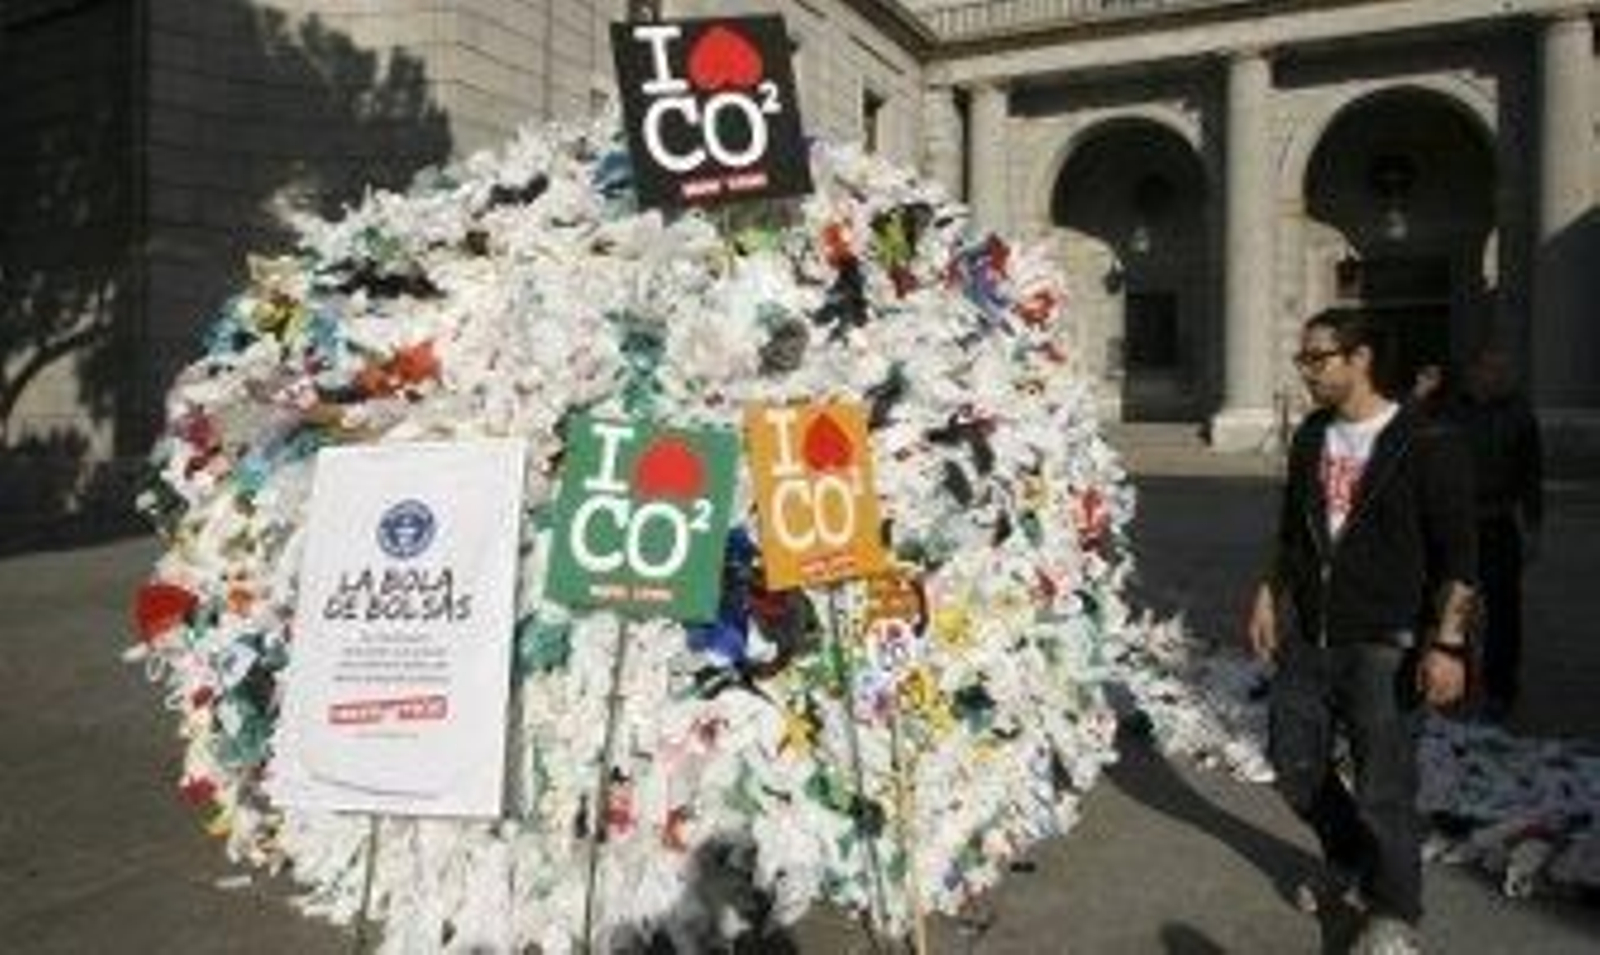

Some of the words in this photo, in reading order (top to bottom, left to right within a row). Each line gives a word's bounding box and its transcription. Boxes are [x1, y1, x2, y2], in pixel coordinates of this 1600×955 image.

[633, 25, 688, 93] I
[584, 423, 634, 491] I
[766, 408, 802, 477] I
